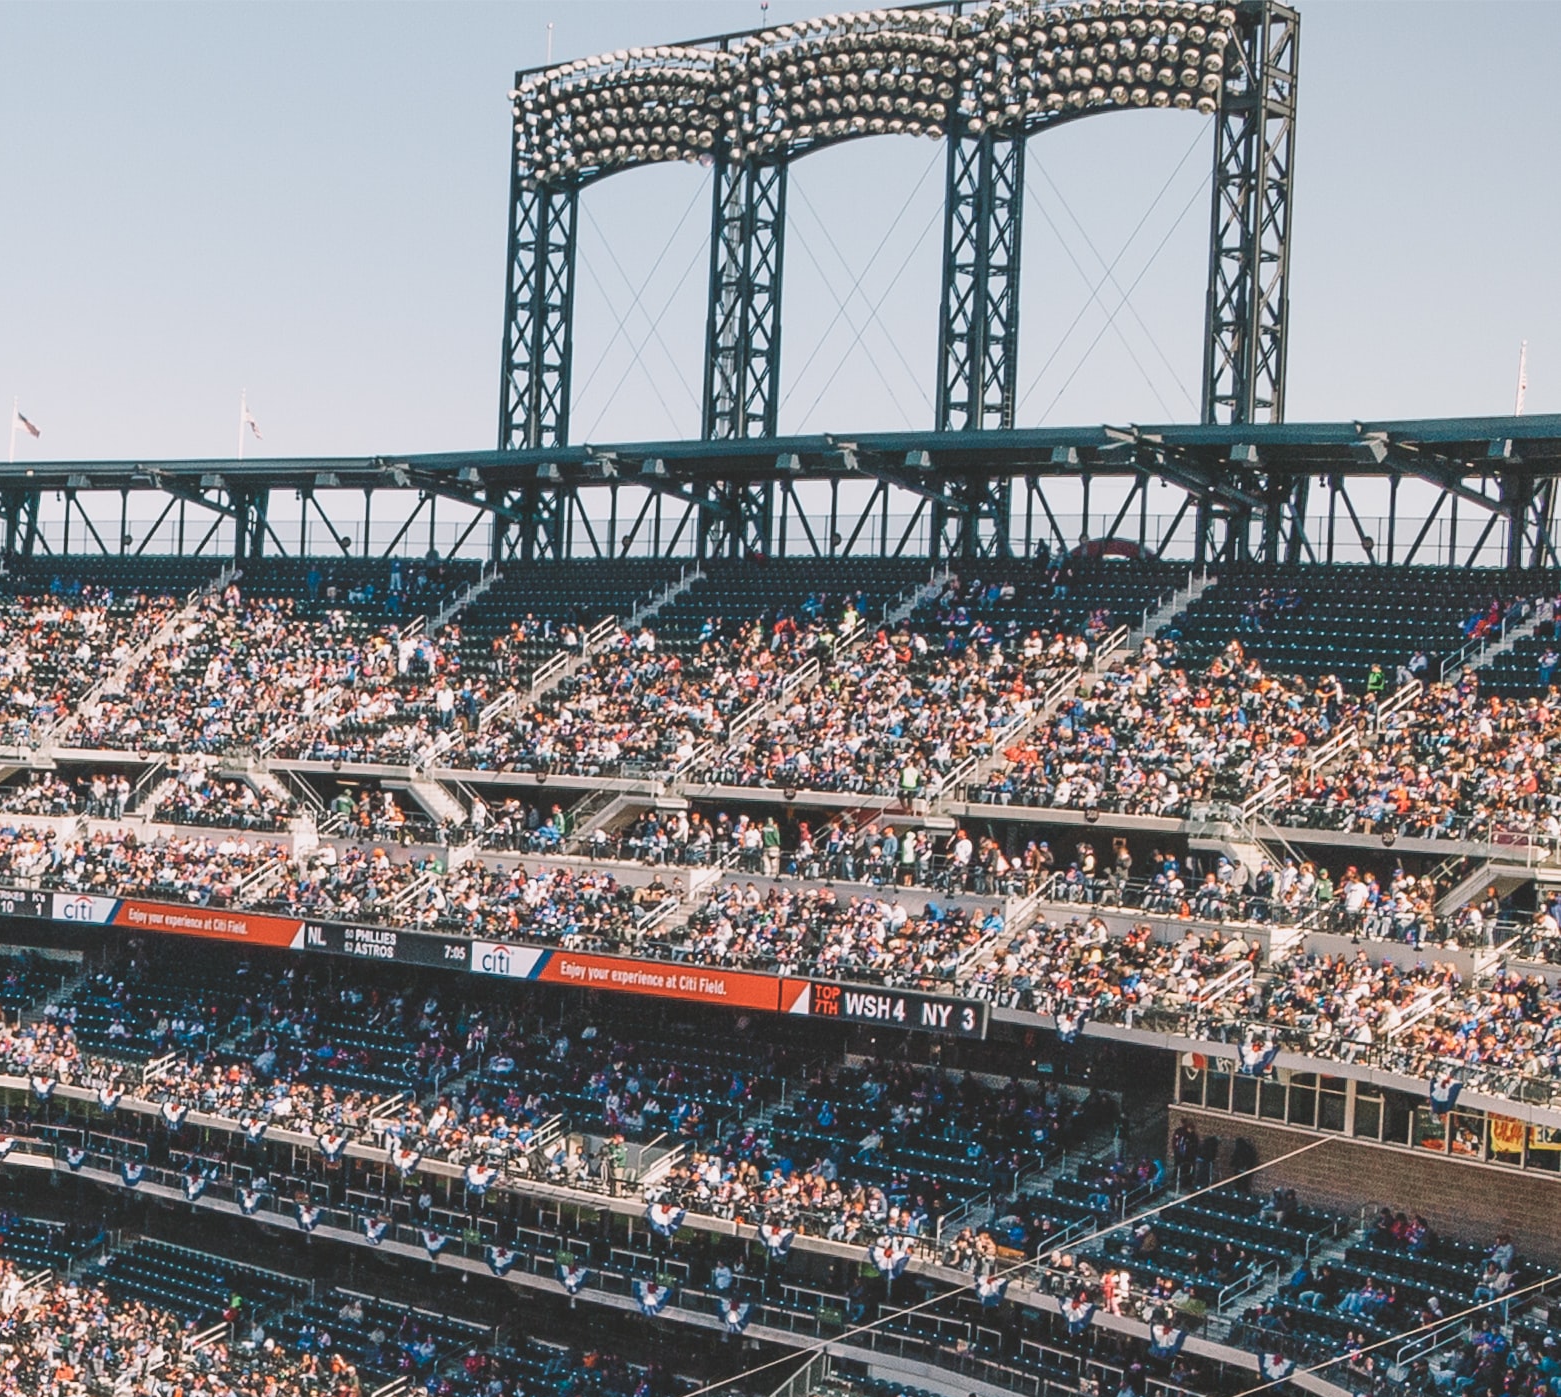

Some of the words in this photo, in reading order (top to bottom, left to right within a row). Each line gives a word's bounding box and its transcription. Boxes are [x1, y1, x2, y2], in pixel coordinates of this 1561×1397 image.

[308, 926, 326, 946] NL
[560, 961, 586, 980] Enjoy
[588, 965, 610, 982] your
[611, 969, 666, 987] experience
[667, 976, 677, 988] at
[679, 976, 698, 991] Citi
[699, 979, 727, 996] Field.
[815, 985, 840, 1000] TOP
[815, 999, 838, 1015] 7TH
[845, 993, 892, 1018] WSH
[892, 1001, 906, 1022] 4
[921, 1003, 953, 1027] NY
[962, 1008, 976, 1031] 3
